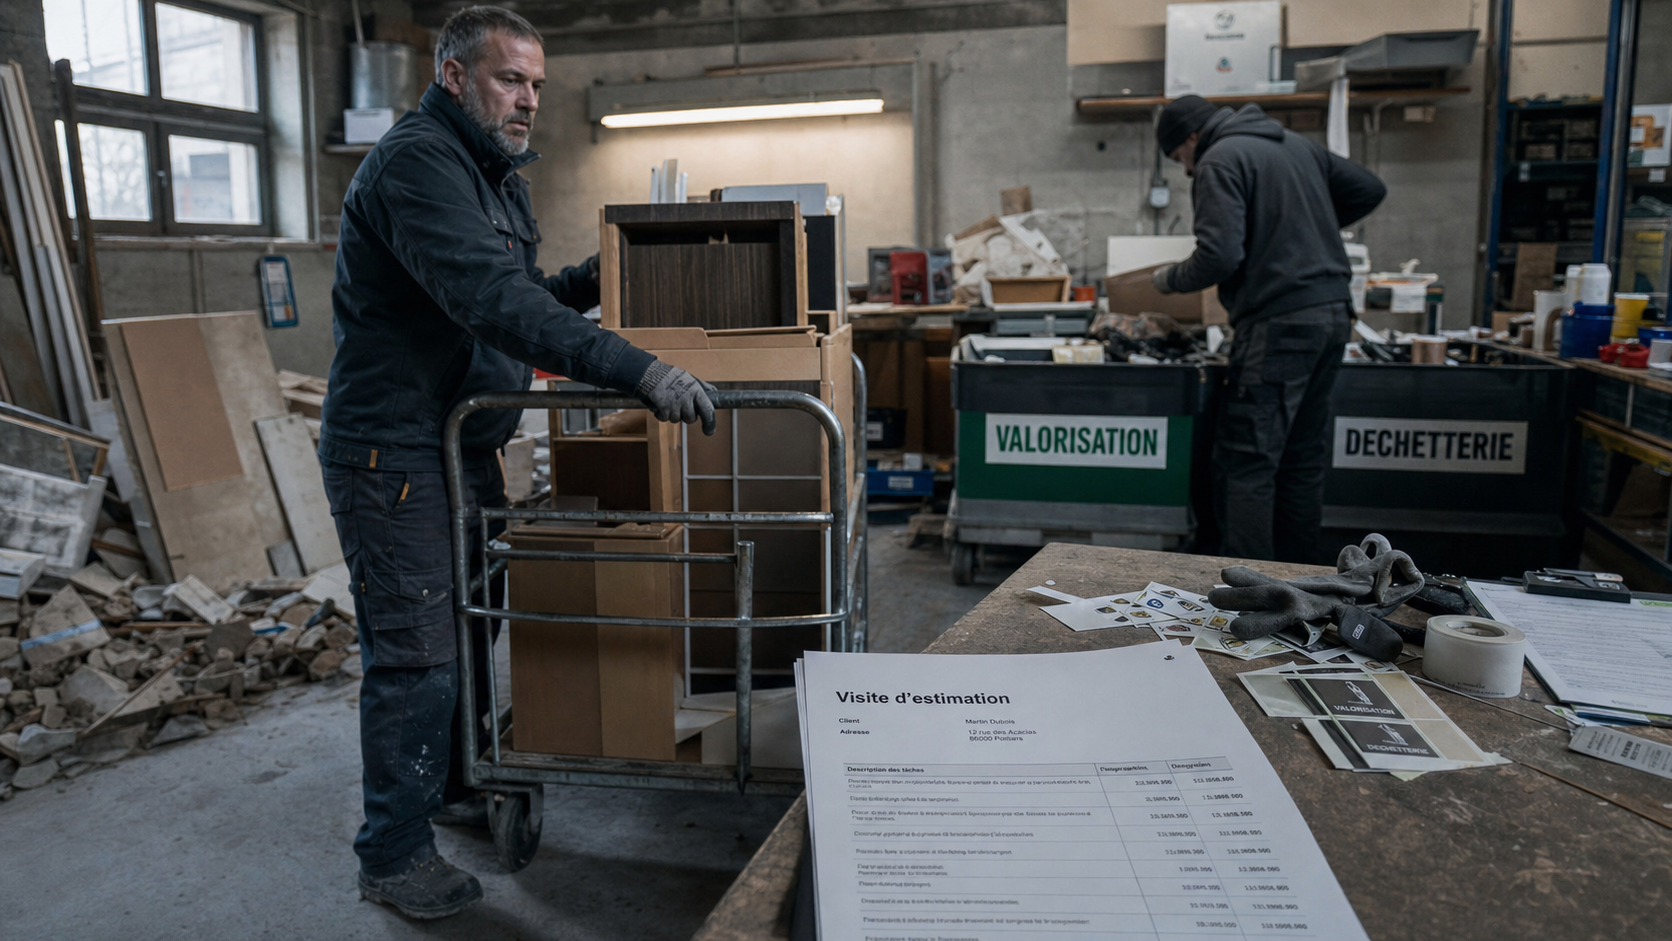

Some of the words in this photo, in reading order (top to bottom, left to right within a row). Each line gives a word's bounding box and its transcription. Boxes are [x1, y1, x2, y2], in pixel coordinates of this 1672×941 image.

[995, 424, 1159, 457] VALORISATION
[1345, 428, 1514, 462] DECHETTERIE
[836, 690, 889, 704] Visite
[895, 691, 1011, 705] d’estimation
[1333, 704, 1396, 715] VALORISATION
[1366, 743, 1430, 755] DECHETTERIE
